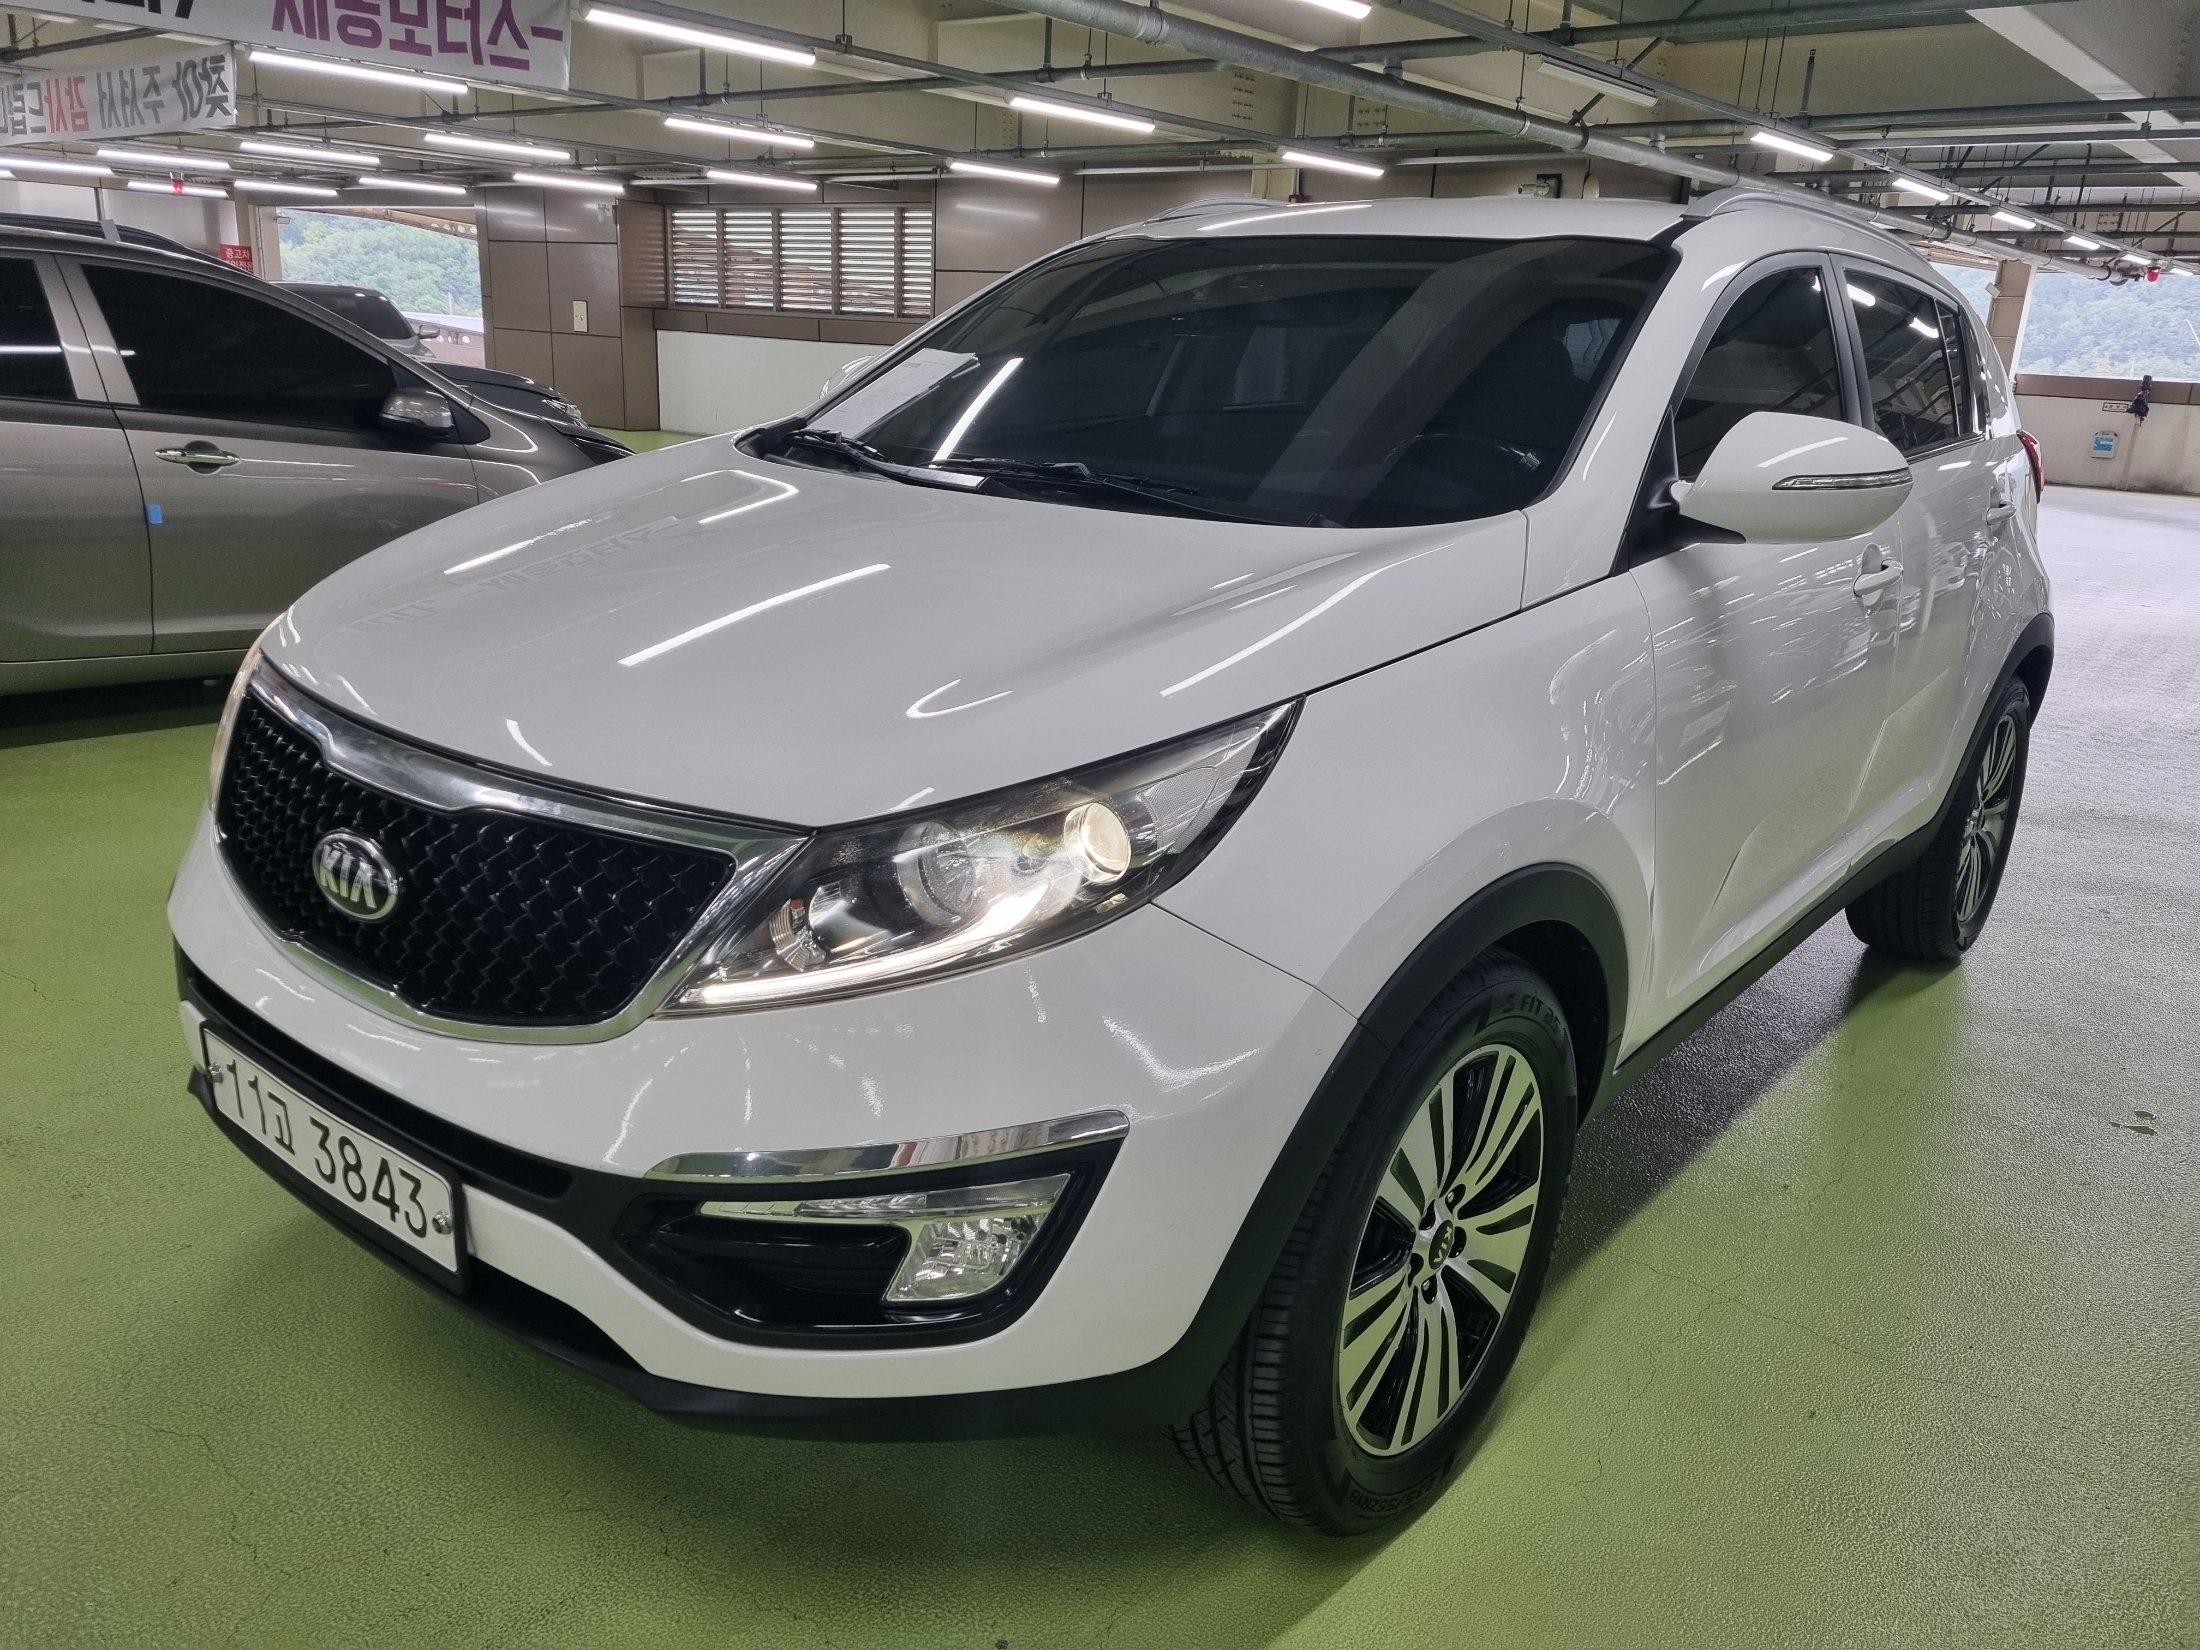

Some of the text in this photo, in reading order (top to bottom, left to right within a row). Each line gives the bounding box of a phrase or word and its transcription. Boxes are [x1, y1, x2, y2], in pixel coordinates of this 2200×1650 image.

[226, 248, 250, 260] 중고차
[226, 260, 253, 272] 전문
[320, 841, 378, 909] KIA
[1520, 993, 1544, 1015] FIT
[226, 1059, 428, 1239] 11고 3843
